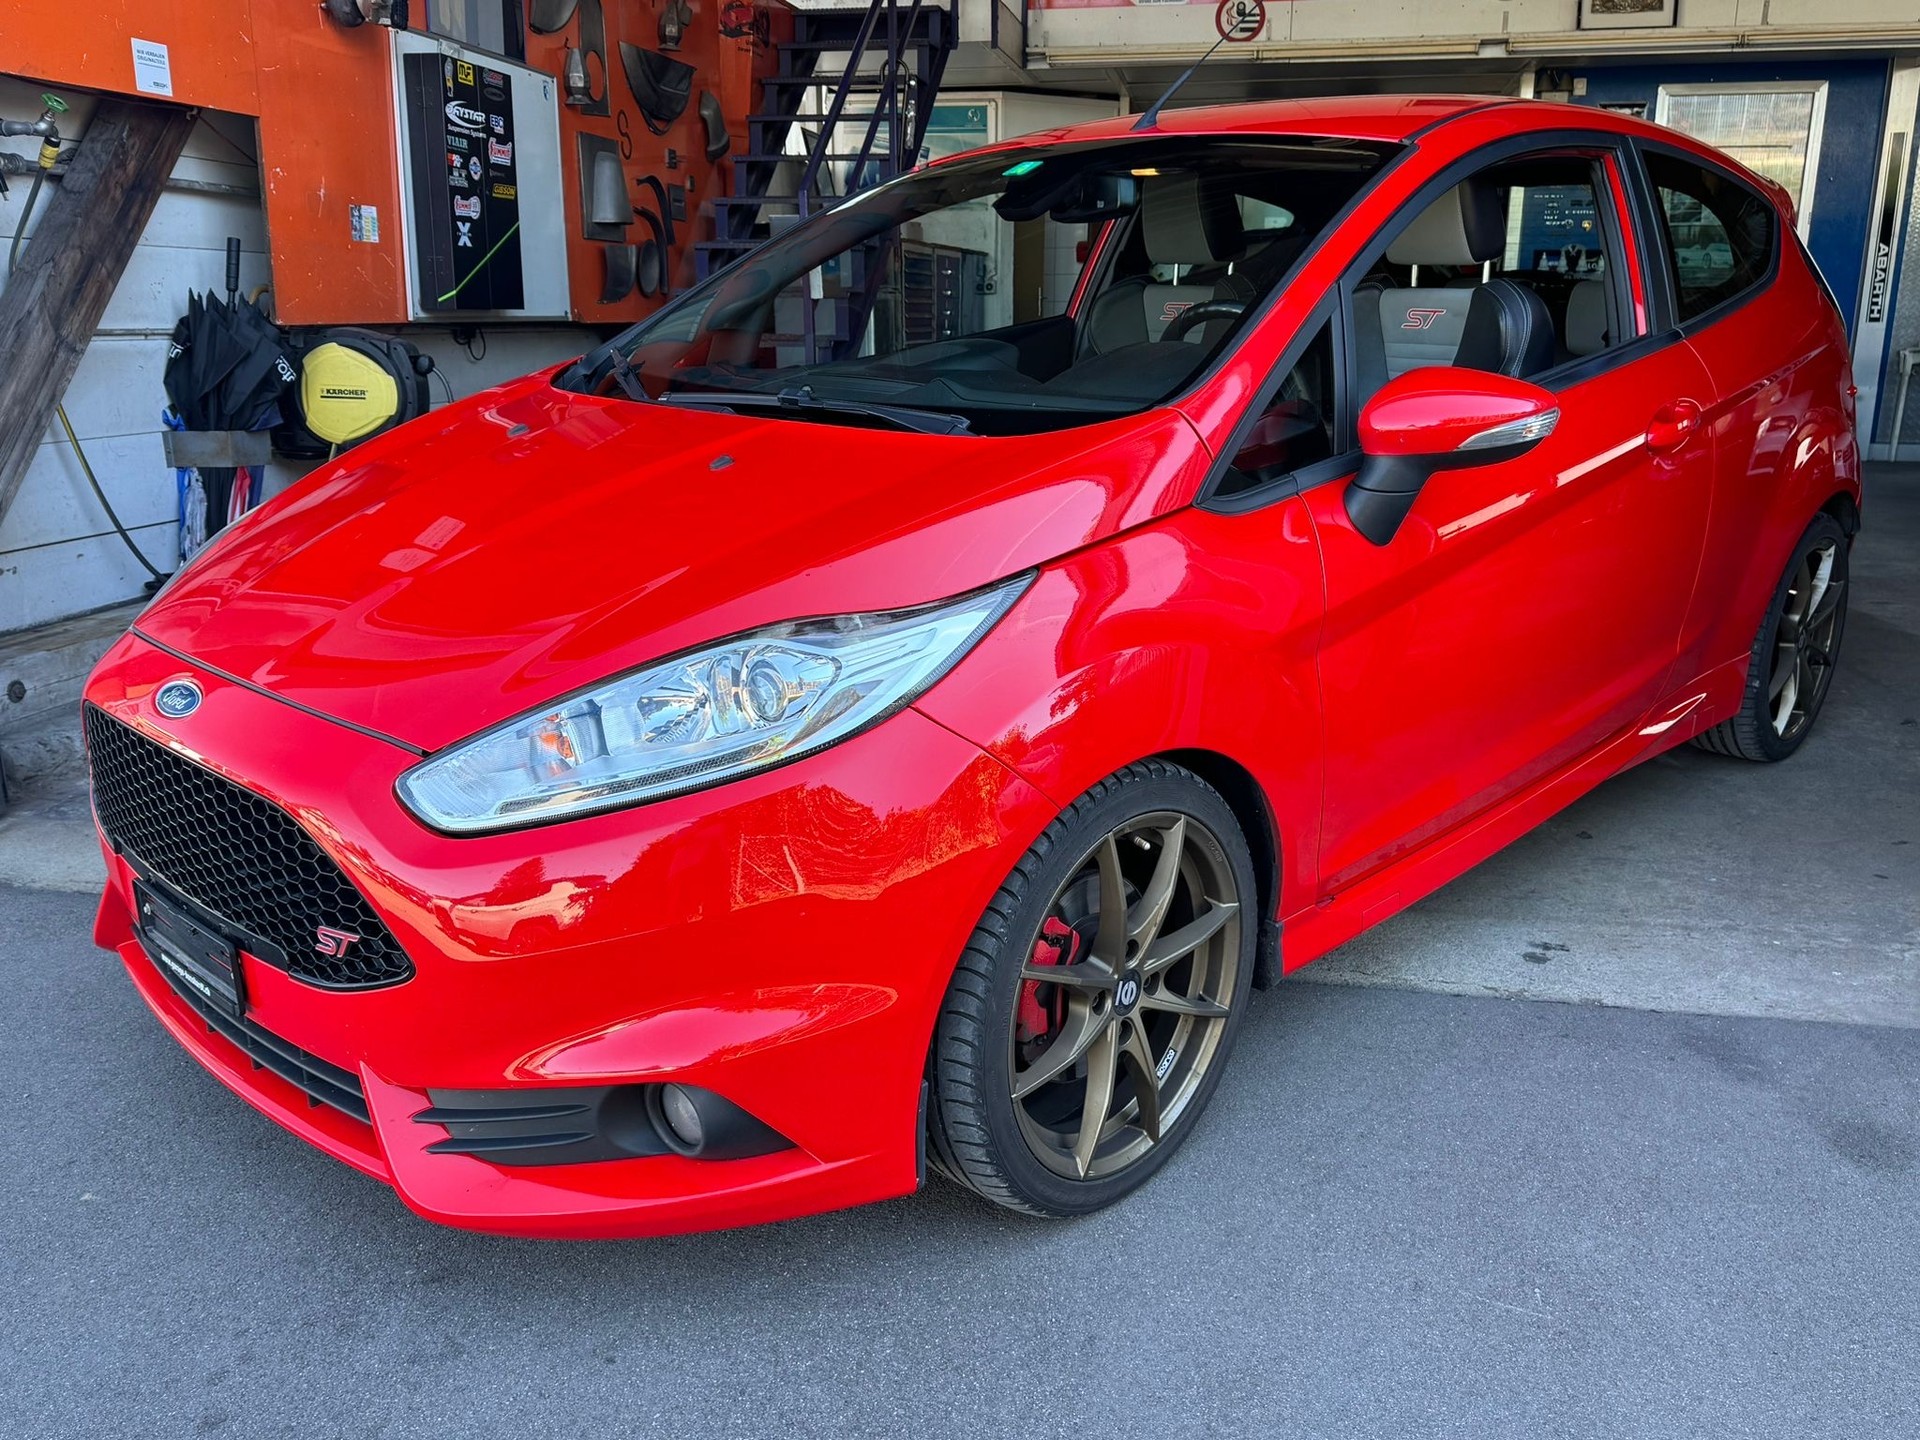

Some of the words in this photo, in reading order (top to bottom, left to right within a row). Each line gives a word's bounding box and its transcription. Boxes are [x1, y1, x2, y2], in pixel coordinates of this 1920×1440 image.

[447, 123, 471, 136] Suspension
[470, 129, 487, 139] Systems
[447, 135, 469, 149] VIAIR
[1869, 242, 1889, 319] ABARTH
[1400, 307, 1447, 330] ST
[162, 686, 192, 710] Ford
[314, 925, 360, 958] ST
